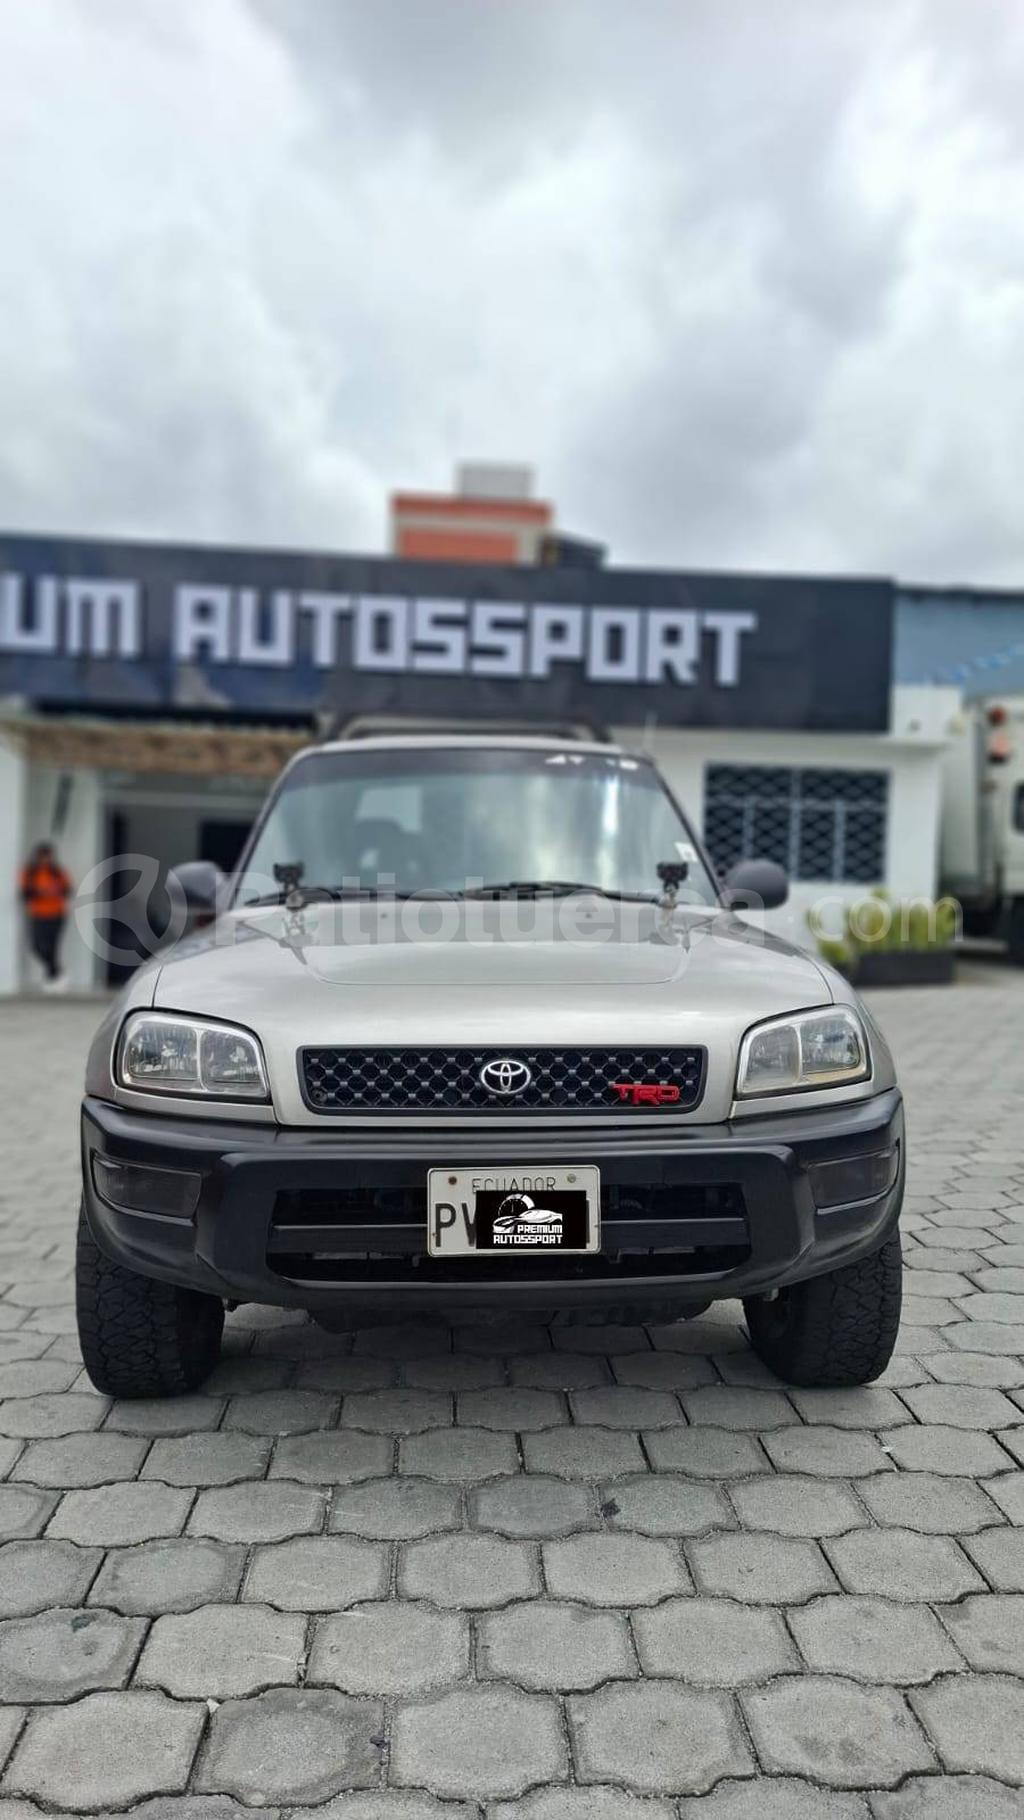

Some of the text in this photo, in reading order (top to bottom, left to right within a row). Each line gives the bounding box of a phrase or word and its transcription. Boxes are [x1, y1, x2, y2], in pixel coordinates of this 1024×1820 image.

[174, 582, 757, 684] AUTOSSPORT
[613, 1084, 680, 1105] TRD
[472, 1176, 556, 1192] ECUADOR
